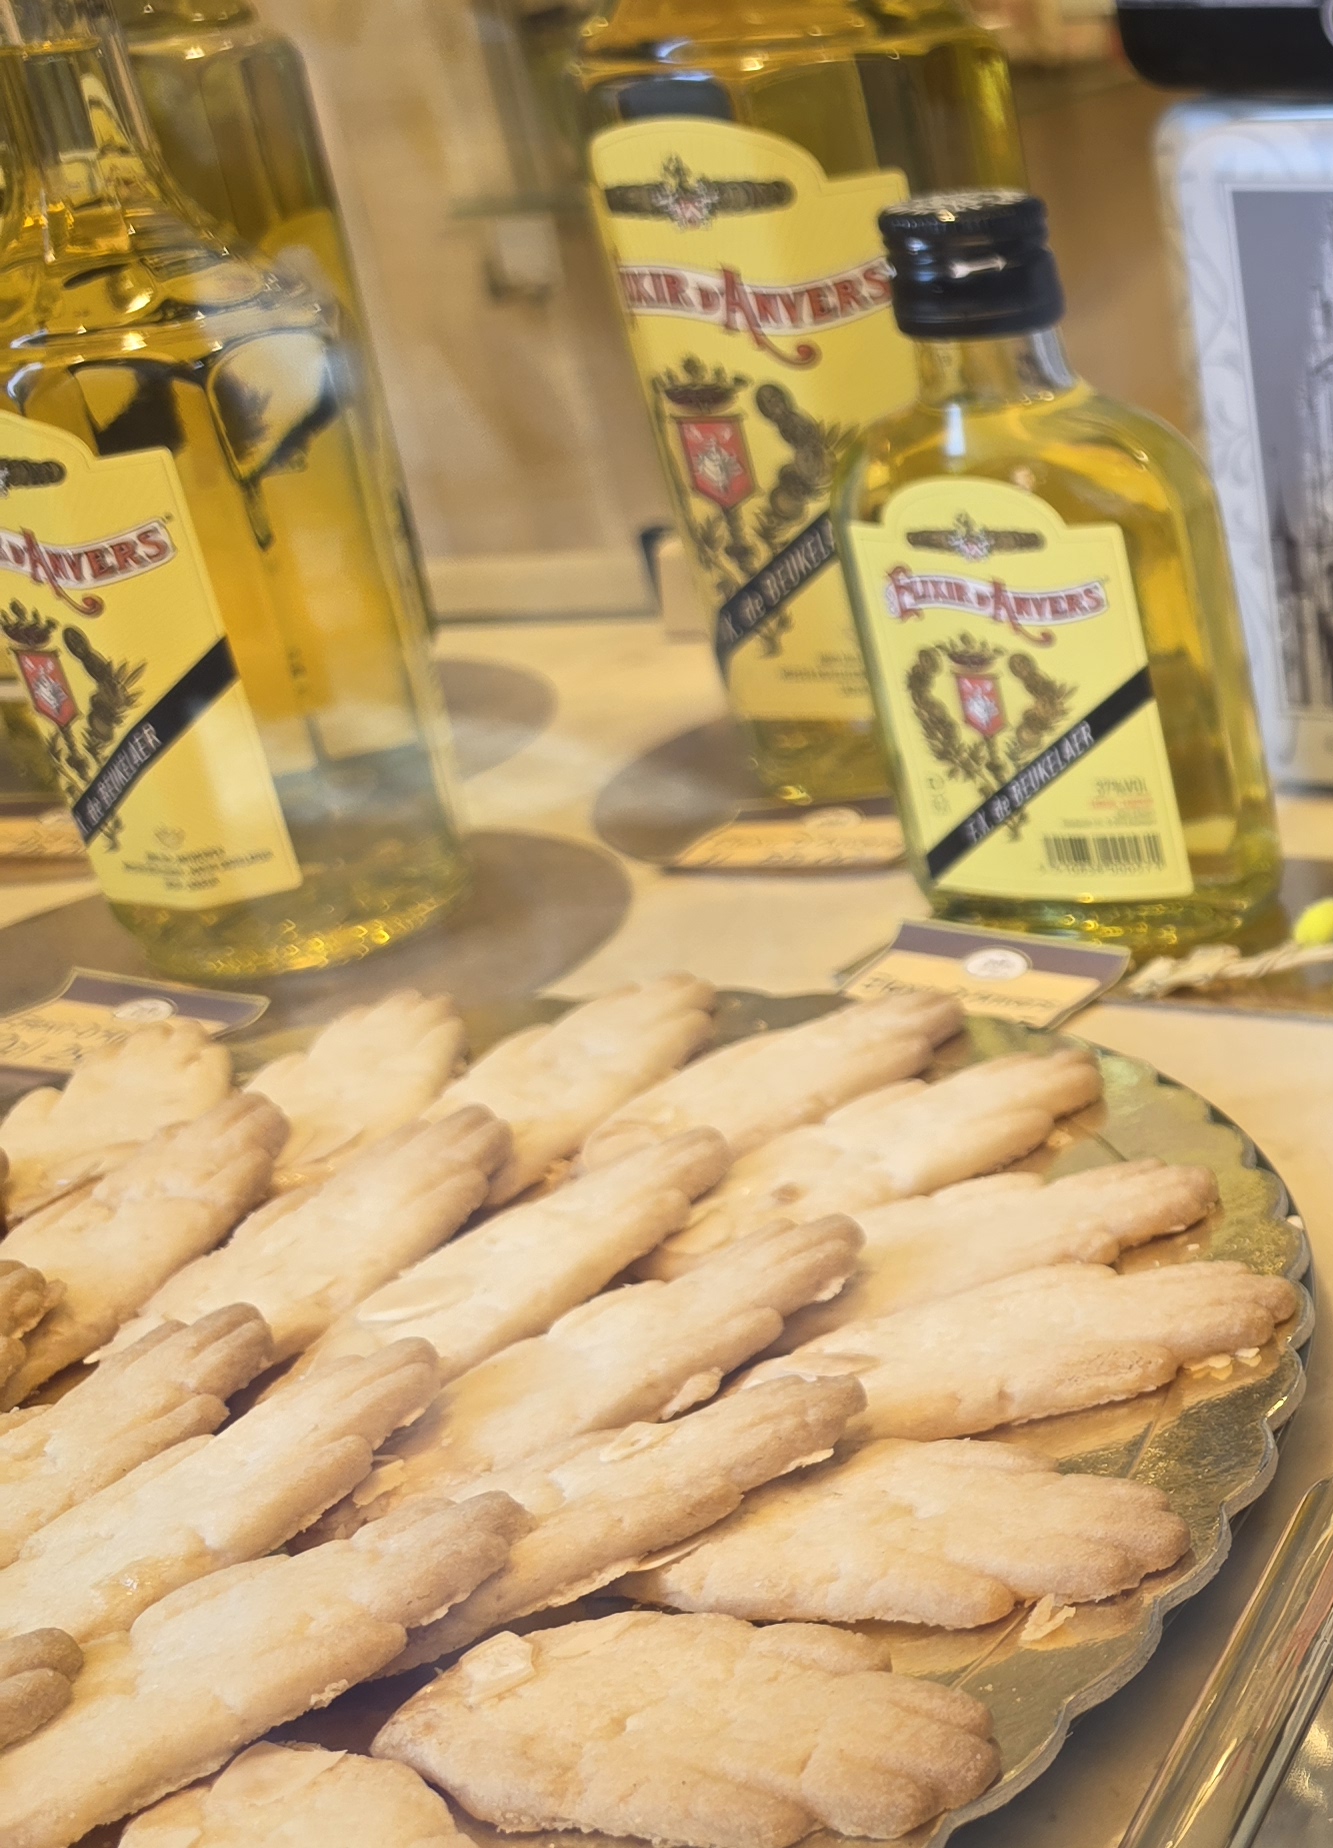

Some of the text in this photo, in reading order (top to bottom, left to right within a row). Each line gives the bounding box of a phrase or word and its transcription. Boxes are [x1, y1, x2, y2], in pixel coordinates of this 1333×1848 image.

[761, 516, 836, 606] BEUKEL
[887, 566, 970, 622] ELIXIR
[1009, 719, 1096, 806] BEUKELAER
